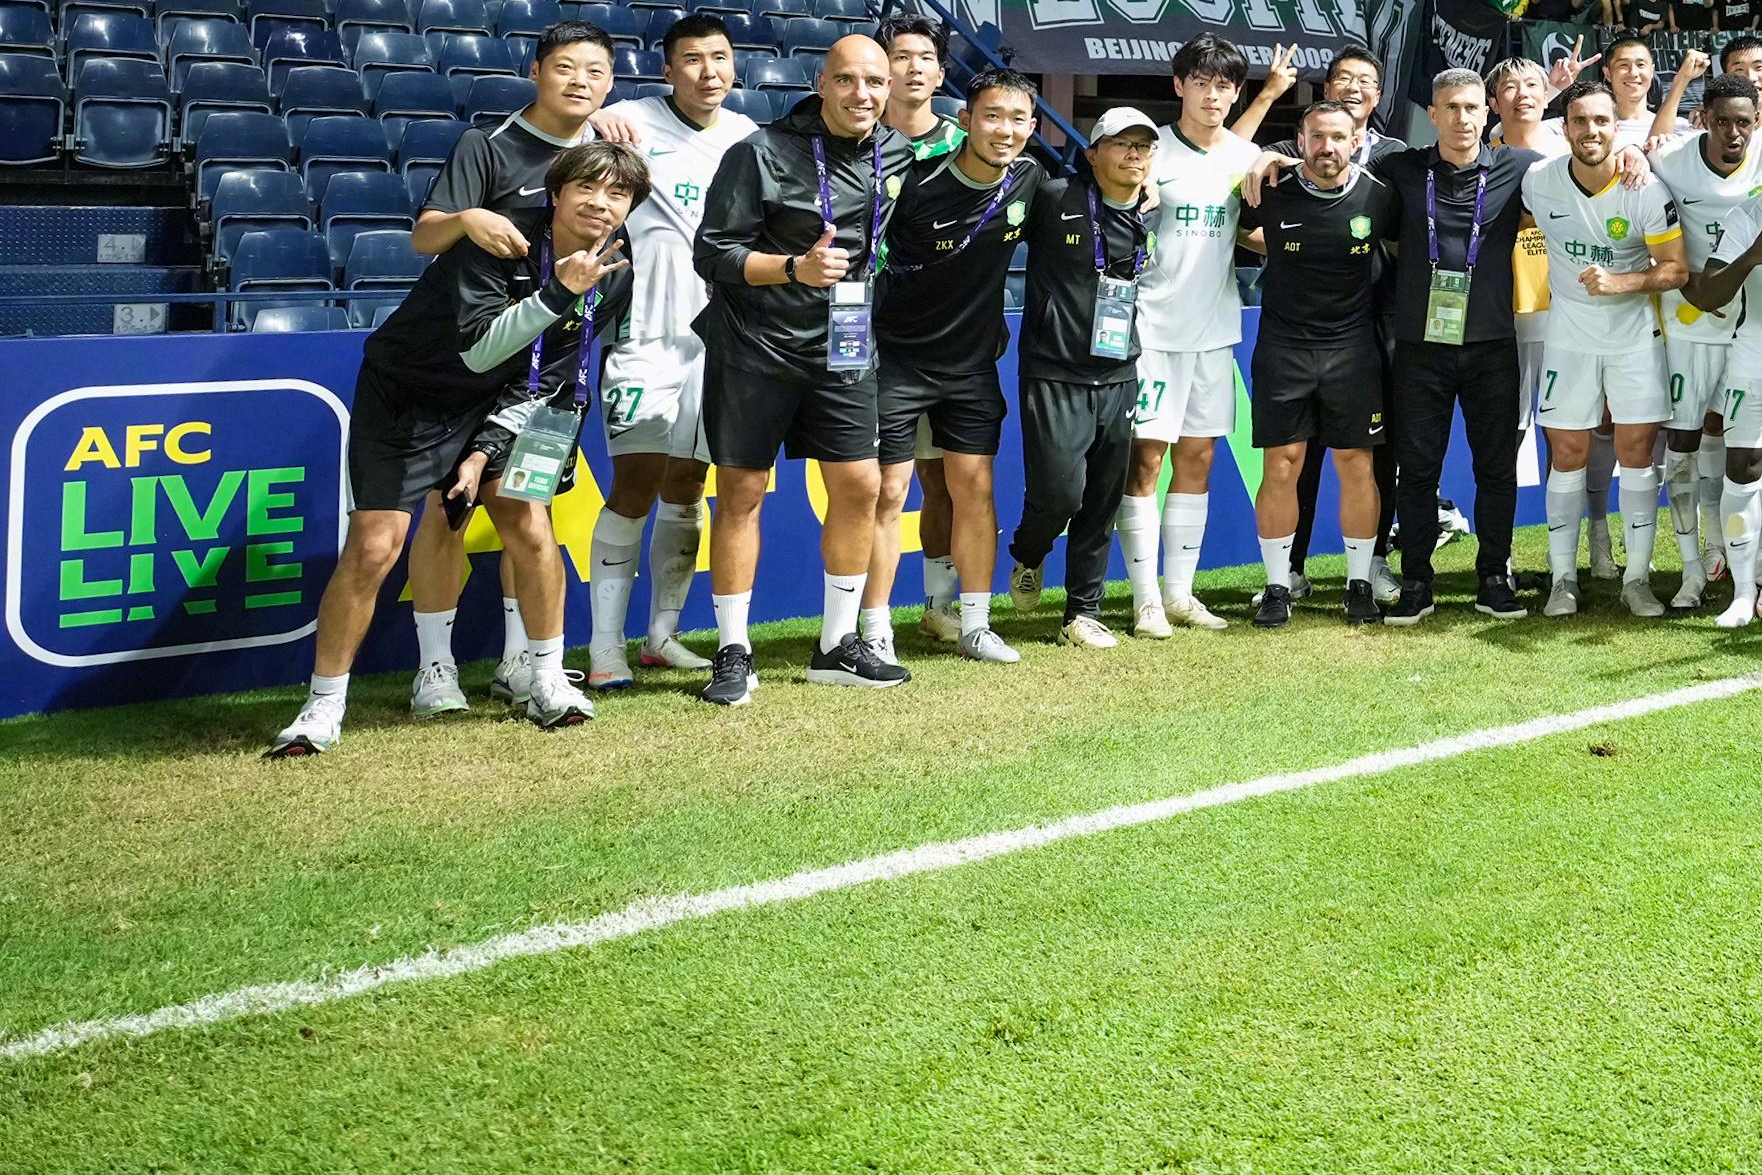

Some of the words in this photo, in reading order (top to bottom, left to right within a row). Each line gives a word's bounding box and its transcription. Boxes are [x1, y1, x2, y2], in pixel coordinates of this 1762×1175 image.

[1176, 203, 1226, 229] 中赫
[935, 239, 954, 251] ZKX
[1066, 233, 1080, 245] MT
[1176, 230, 1222, 239] SINOBO
[1564, 240, 1614, 263] 中赫
[583, 304, 595, 322] AFC
[531, 350, 541, 370] AFC
[578, 368, 588, 386] AFC
[1546, 369, 1558, 401] 7
[1671, 373, 1685, 403] 0
[606, 387, 644, 425] 27
[1136, 377, 1167, 413] 47
[64, 422, 212, 471] AFC
[60, 466, 305, 551] LIVE
